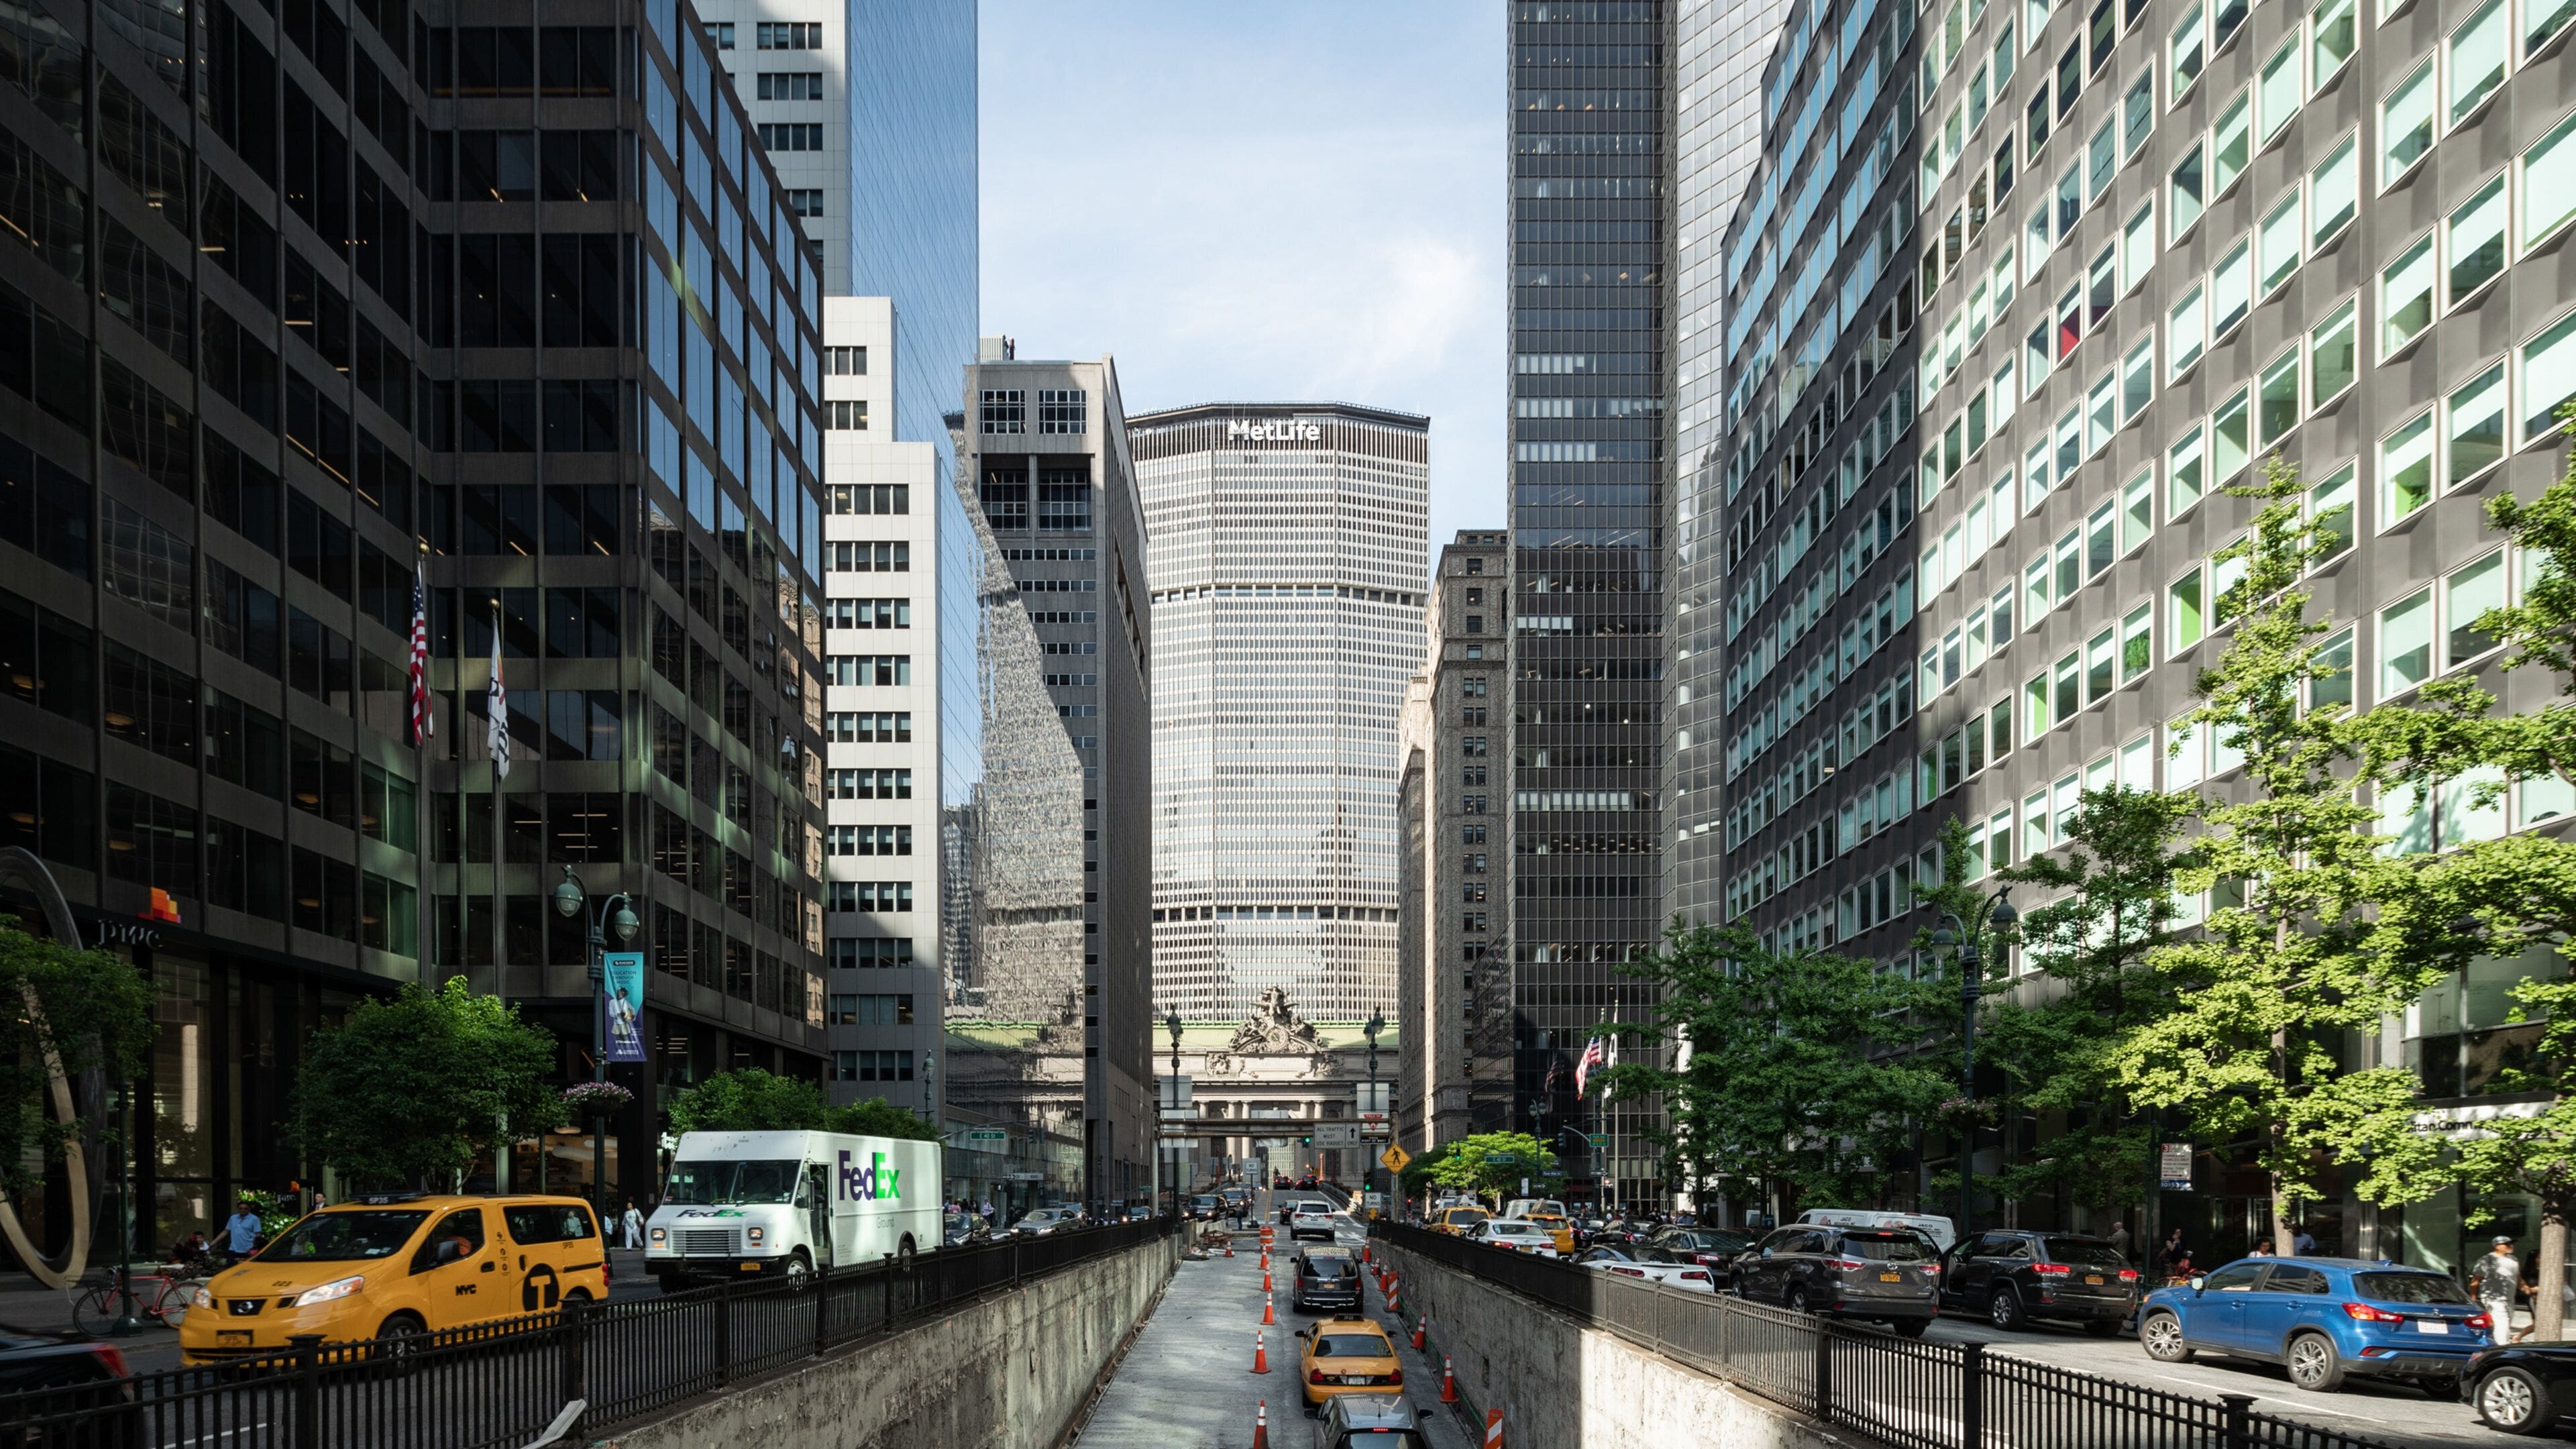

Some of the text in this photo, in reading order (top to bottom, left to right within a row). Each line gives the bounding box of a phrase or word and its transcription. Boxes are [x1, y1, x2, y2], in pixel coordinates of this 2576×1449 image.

[1229, 420, 1320, 441] MetLife
[98, 920, 163, 949] pwc
[839, 1150, 900, 1201] FedEx
[676, 1209, 749, 1218] FedEx
[877, 1217, 894, 1228] Ground
[455, 1284, 476, 1296] NYC
